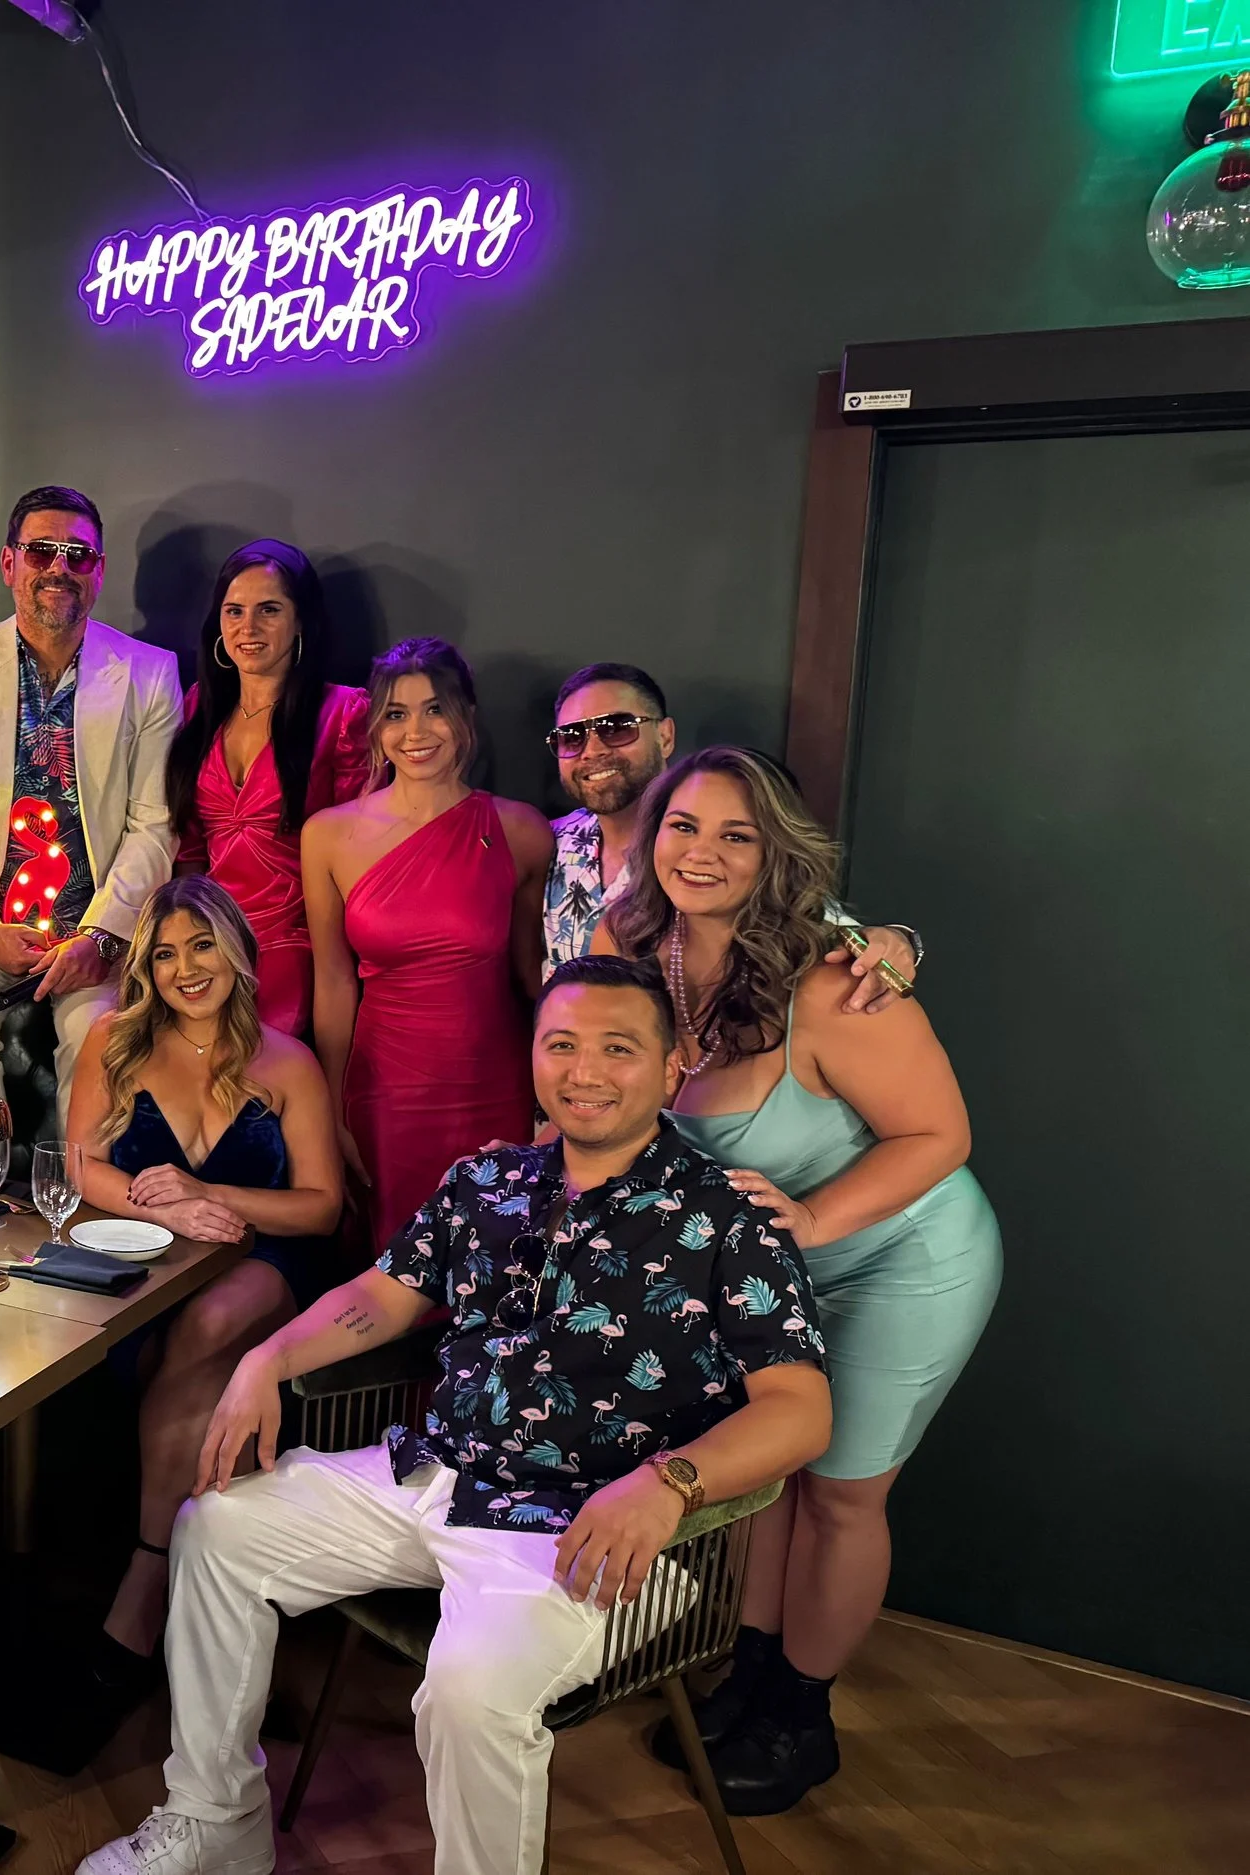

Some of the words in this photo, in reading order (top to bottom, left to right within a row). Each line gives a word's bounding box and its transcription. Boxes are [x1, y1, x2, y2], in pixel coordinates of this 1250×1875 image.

[85, 224, 260, 315] HAPPY
[264, 186, 523, 287] BIRTHDAY
[190, 276, 410, 369] SIDECAR
